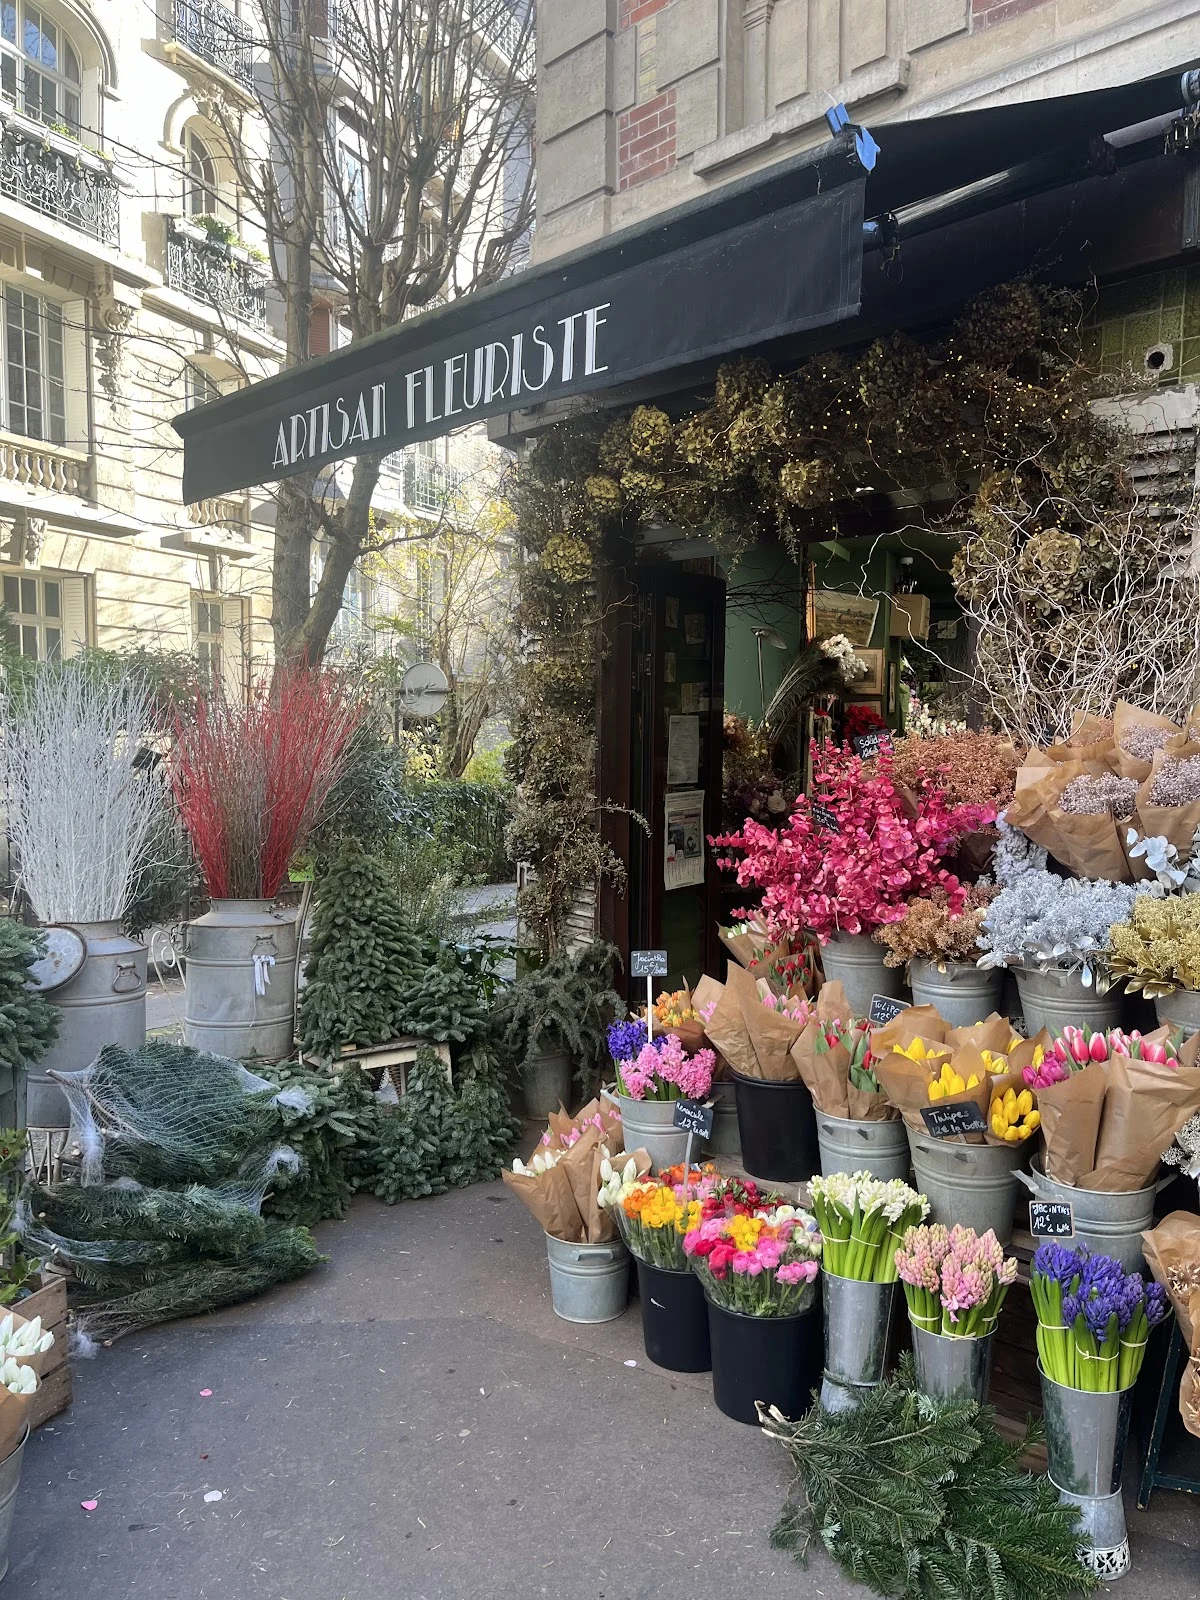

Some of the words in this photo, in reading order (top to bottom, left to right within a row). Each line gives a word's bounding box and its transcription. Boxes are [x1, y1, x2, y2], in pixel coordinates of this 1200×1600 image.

[272, 382, 387, 469] ARTISAN
[405, 302, 611, 429] FLEURISTE
[928, 1110, 970, 1124] Tulipes
[932, 1124, 950, 1136] 12€
[950, 1124, 962, 1134] la
[961, 1120, 988, 1131] botte
